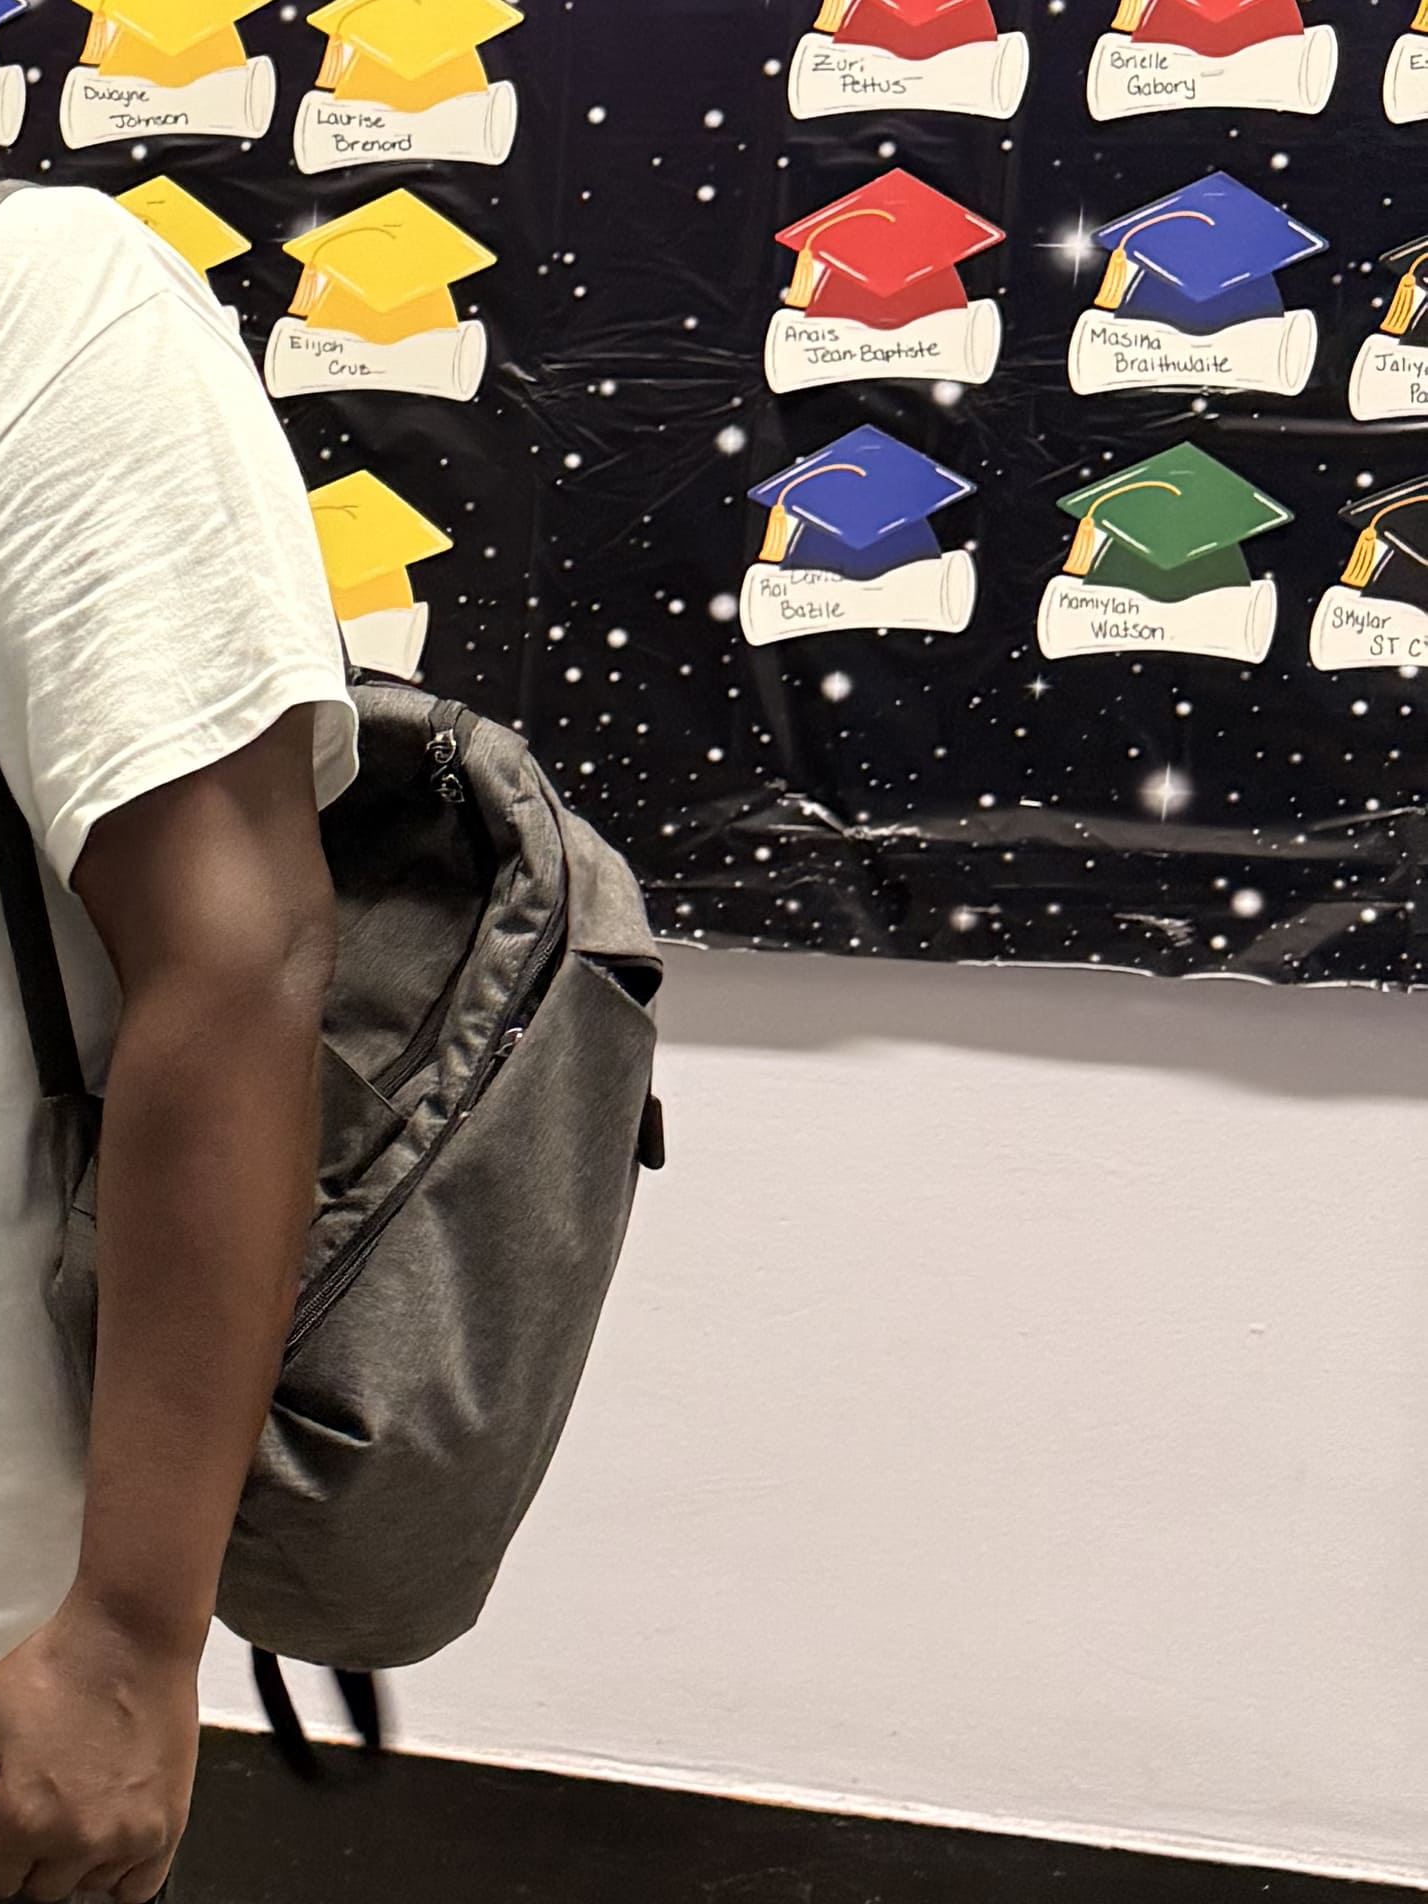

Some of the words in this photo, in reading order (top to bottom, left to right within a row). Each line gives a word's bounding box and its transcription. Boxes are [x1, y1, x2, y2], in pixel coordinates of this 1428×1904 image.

[811, 52, 865, 73] Zuri
[1110, 51, 1169, 71] Brielle
[83, 85, 150, 107] Dwayne
[110, 112, 189, 130] Johnson
[289, 335, 344, 356] Elijah
[785, 326, 841, 344] Anais
[1115, 350, 1234, 375] Braithwaite
[1090, 619, 1166, 641] Watson
[1370, 634, 1400, 656] ST
[1408, 637, 1428, 658] C
